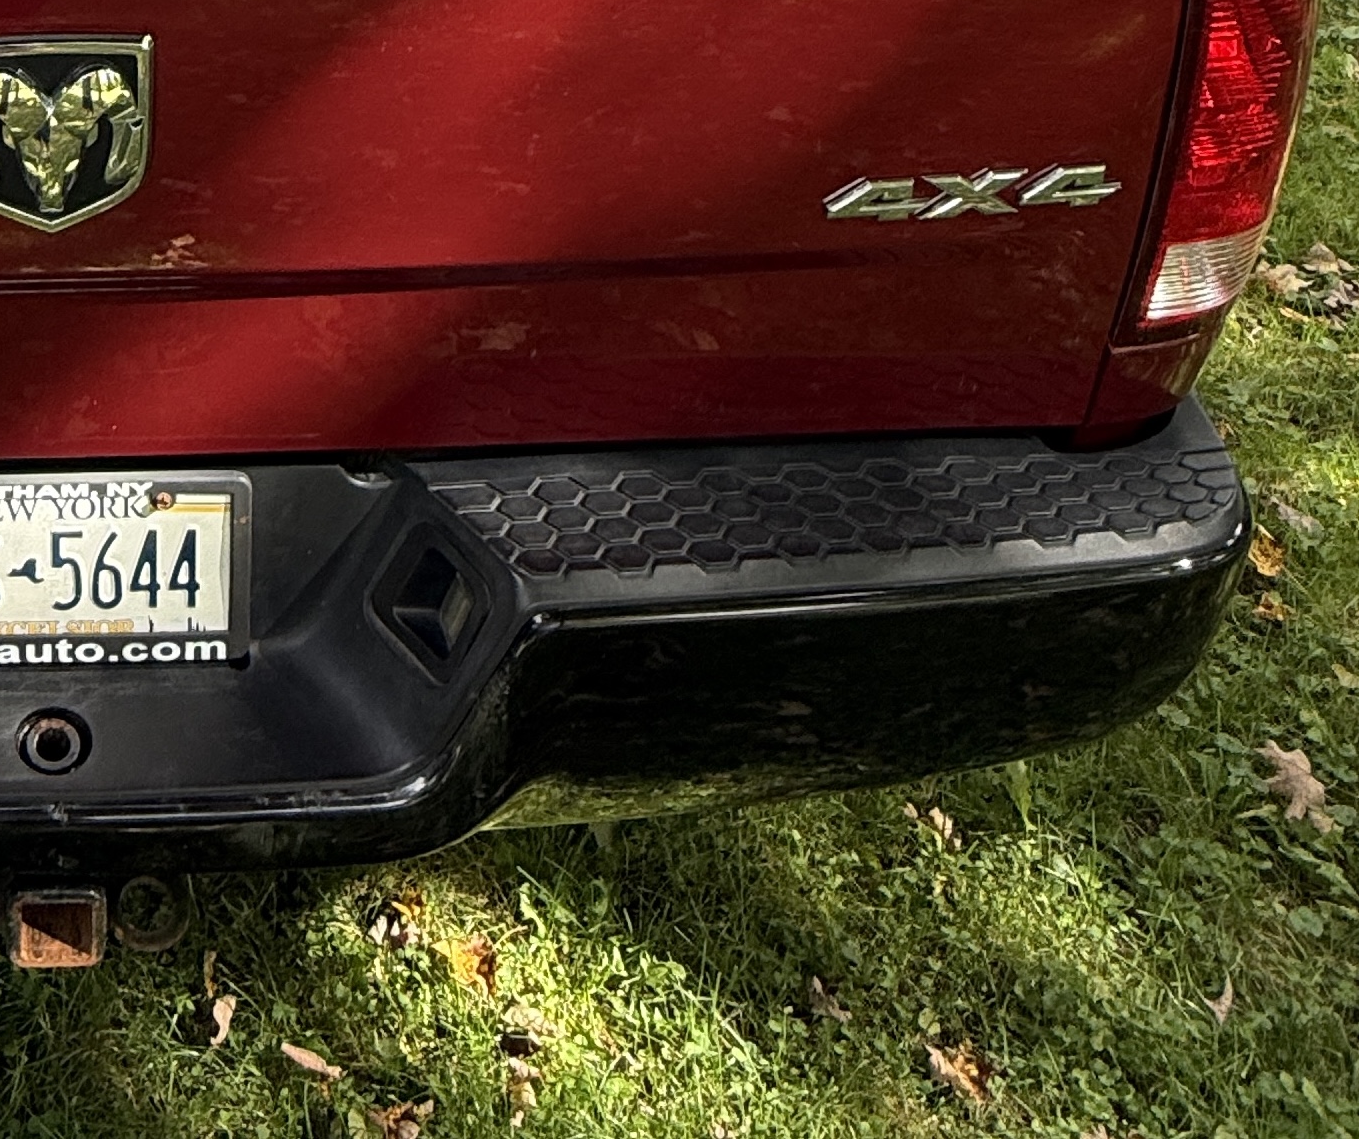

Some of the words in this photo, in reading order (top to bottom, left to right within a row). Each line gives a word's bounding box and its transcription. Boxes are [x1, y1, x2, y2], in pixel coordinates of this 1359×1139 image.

[106, 481, 153, 498] NY
[51, 494, 149, 520] YORK
[50, 529, 201, 611] 5644
